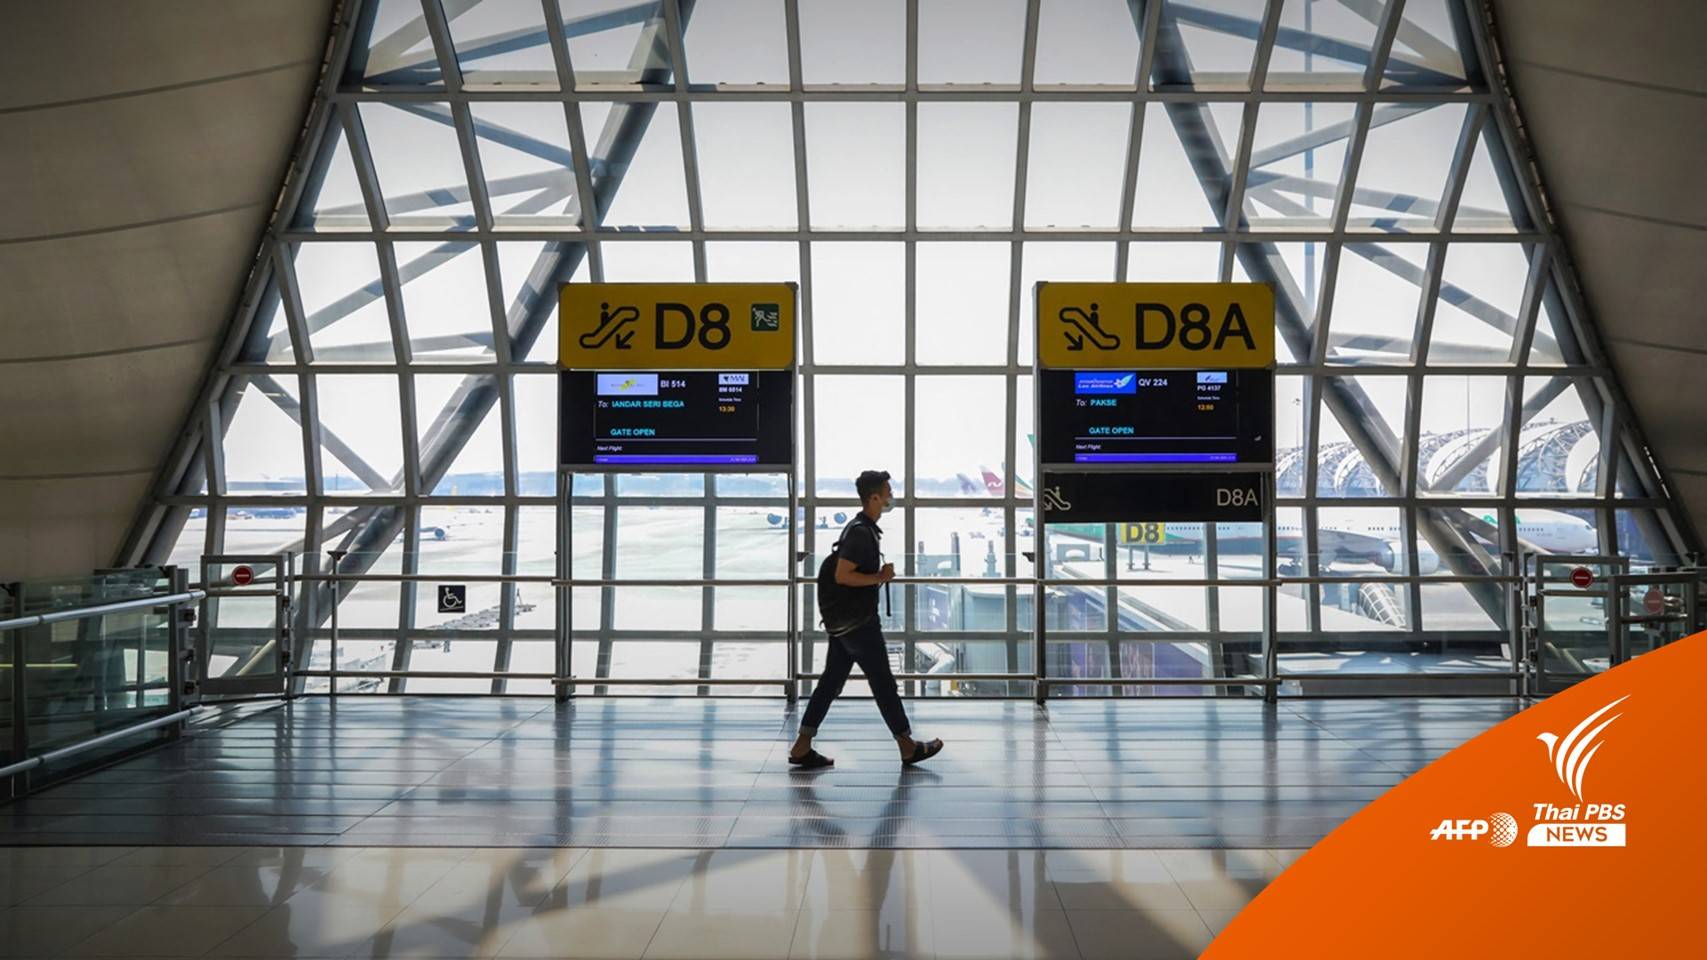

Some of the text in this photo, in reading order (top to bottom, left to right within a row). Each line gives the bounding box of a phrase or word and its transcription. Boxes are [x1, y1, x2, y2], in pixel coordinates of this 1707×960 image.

[655, 303, 731, 350] D8
[1136, 303, 1256, 350] D8A
[660, 380, 686, 388] BI 514
[1138, 379, 1151, 387] QV
[610, 428, 656, 436] GATE OPEN
[1216, 488, 1258, 506] D8A
[1125, 522, 1159, 544] D8
